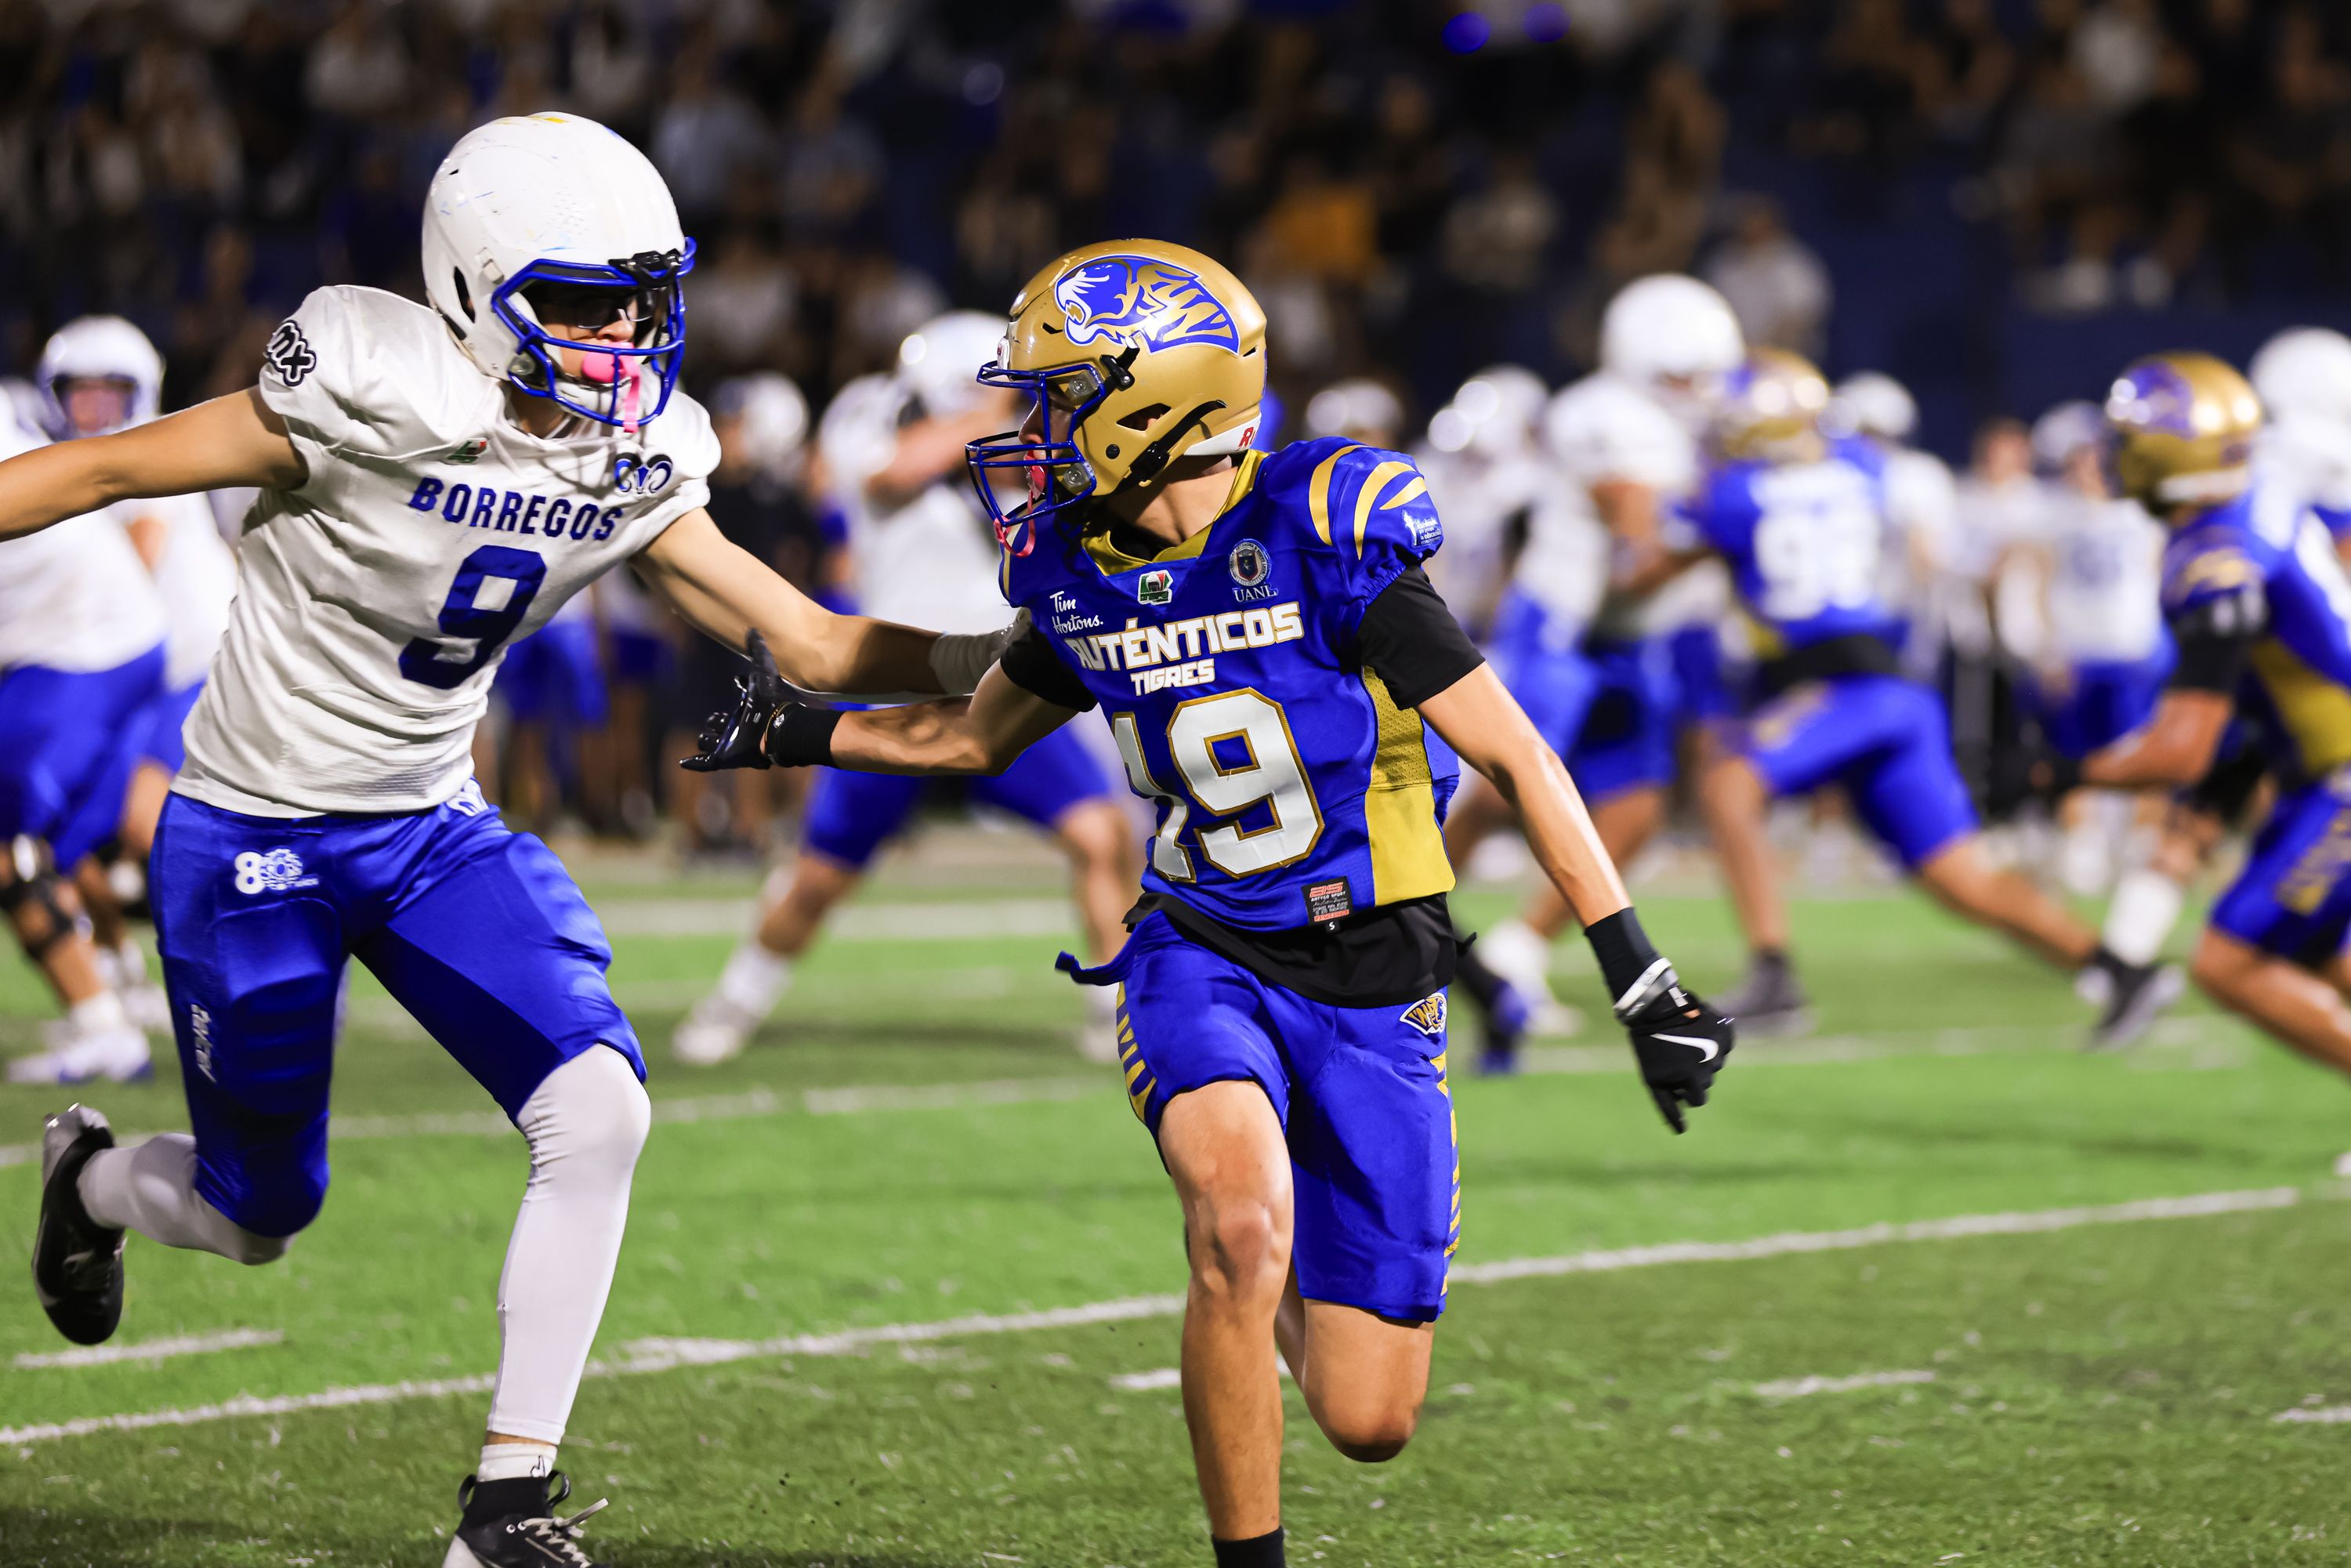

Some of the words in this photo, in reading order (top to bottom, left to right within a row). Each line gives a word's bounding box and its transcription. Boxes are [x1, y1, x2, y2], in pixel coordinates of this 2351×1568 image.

[408, 477, 624, 541] BORREGOS
[398, 545, 548, 690] 9
[1050, 591, 1076, 613] Tim
[1233, 585, 1278, 603] UANL
[1064, 602, 1304, 671] AUTÉNTICOS
[1130, 658, 1215, 696] TIGRES
[1111, 686, 1325, 883] 19
